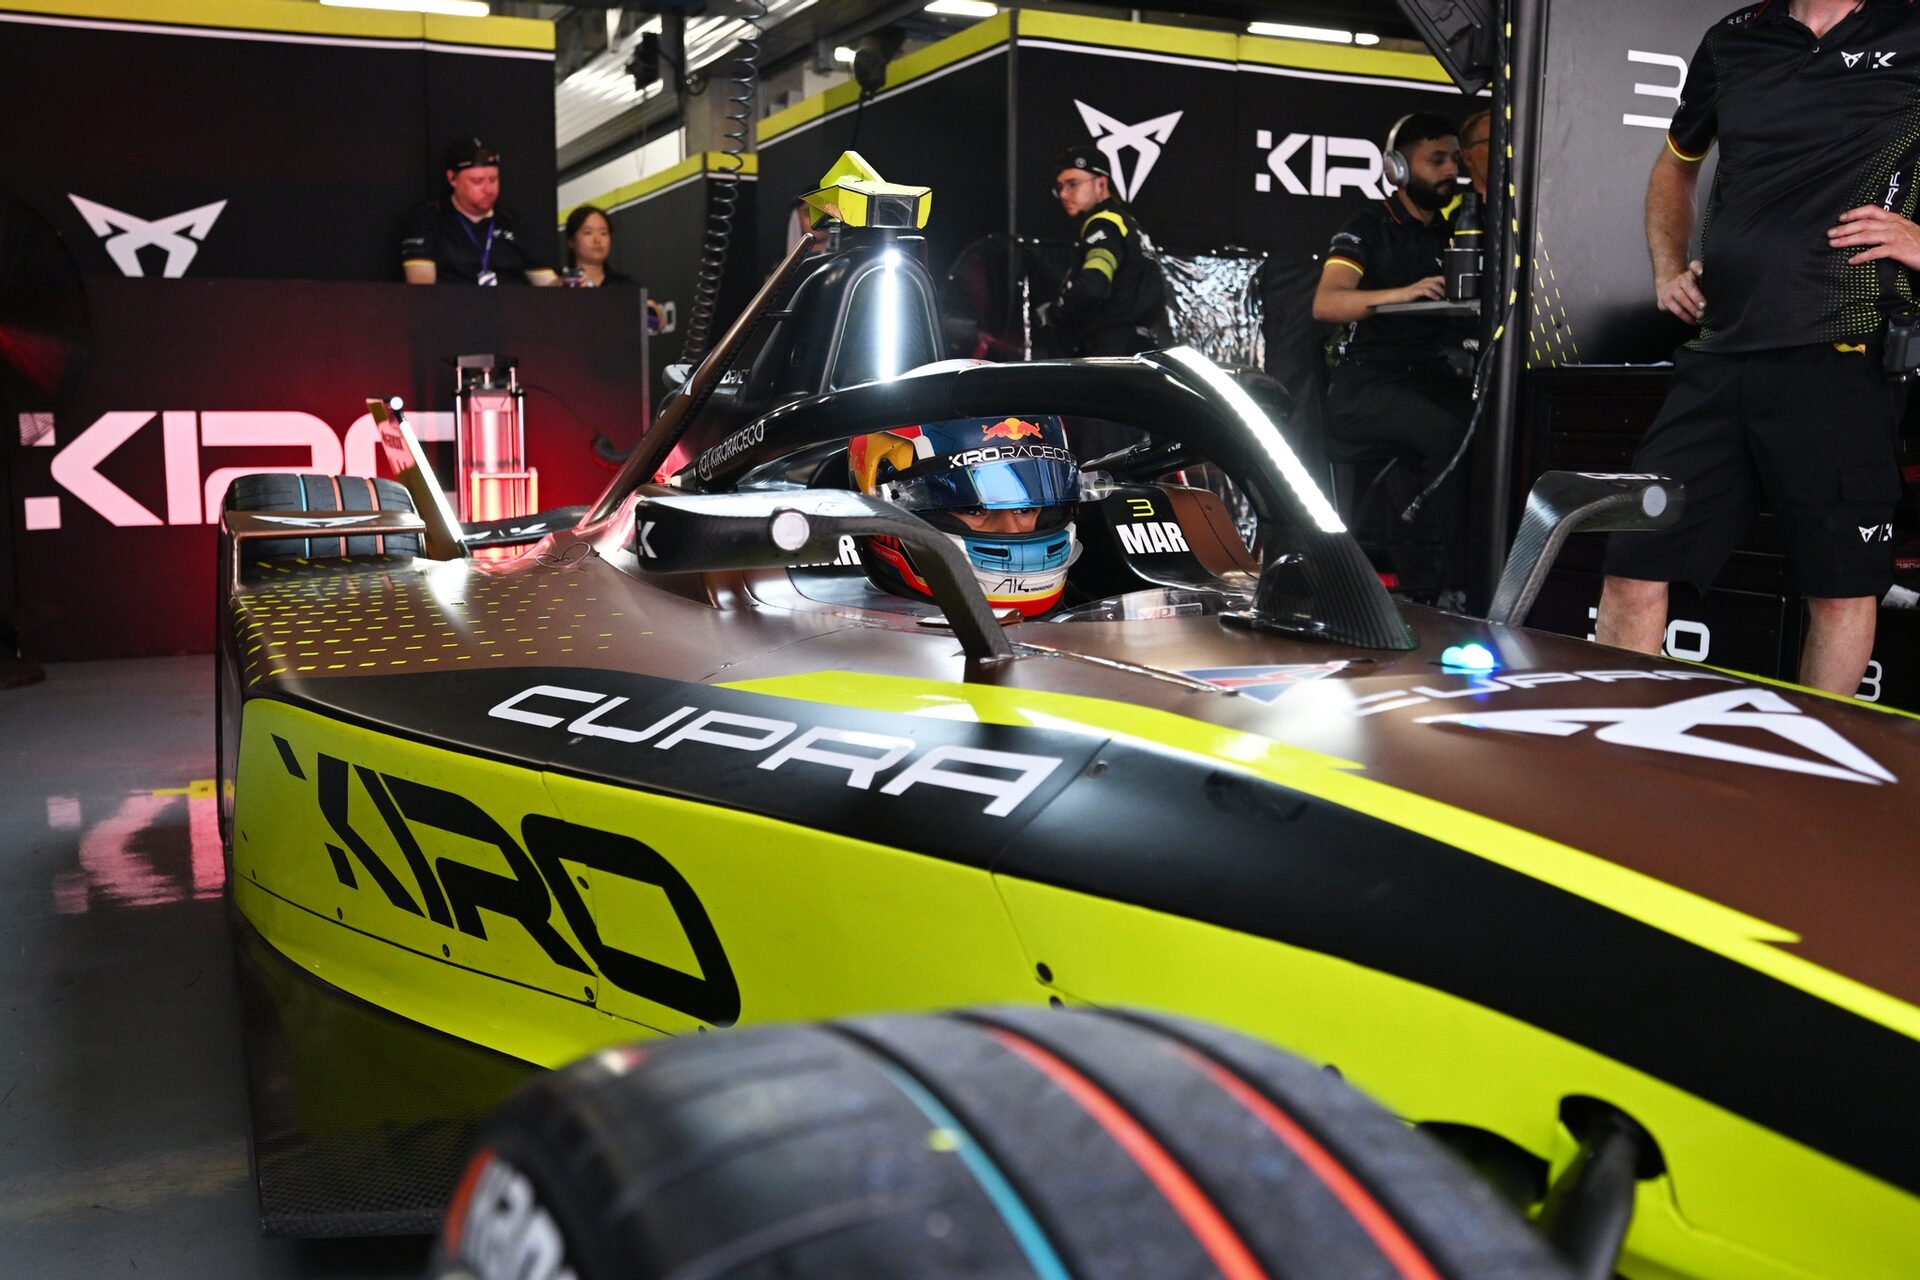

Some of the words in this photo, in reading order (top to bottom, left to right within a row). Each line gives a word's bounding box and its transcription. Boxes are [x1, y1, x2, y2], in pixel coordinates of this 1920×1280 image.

[1622, 49, 1689, 130] 3
[1255, 129, 1472, 201] KIR
[1115, 521, 1191, 554] MAR
[1126, 498, 1155, 517] 3
[488, 684, 1065, 818] CUPRA
[271, 732, 742, 1029] KIRO
